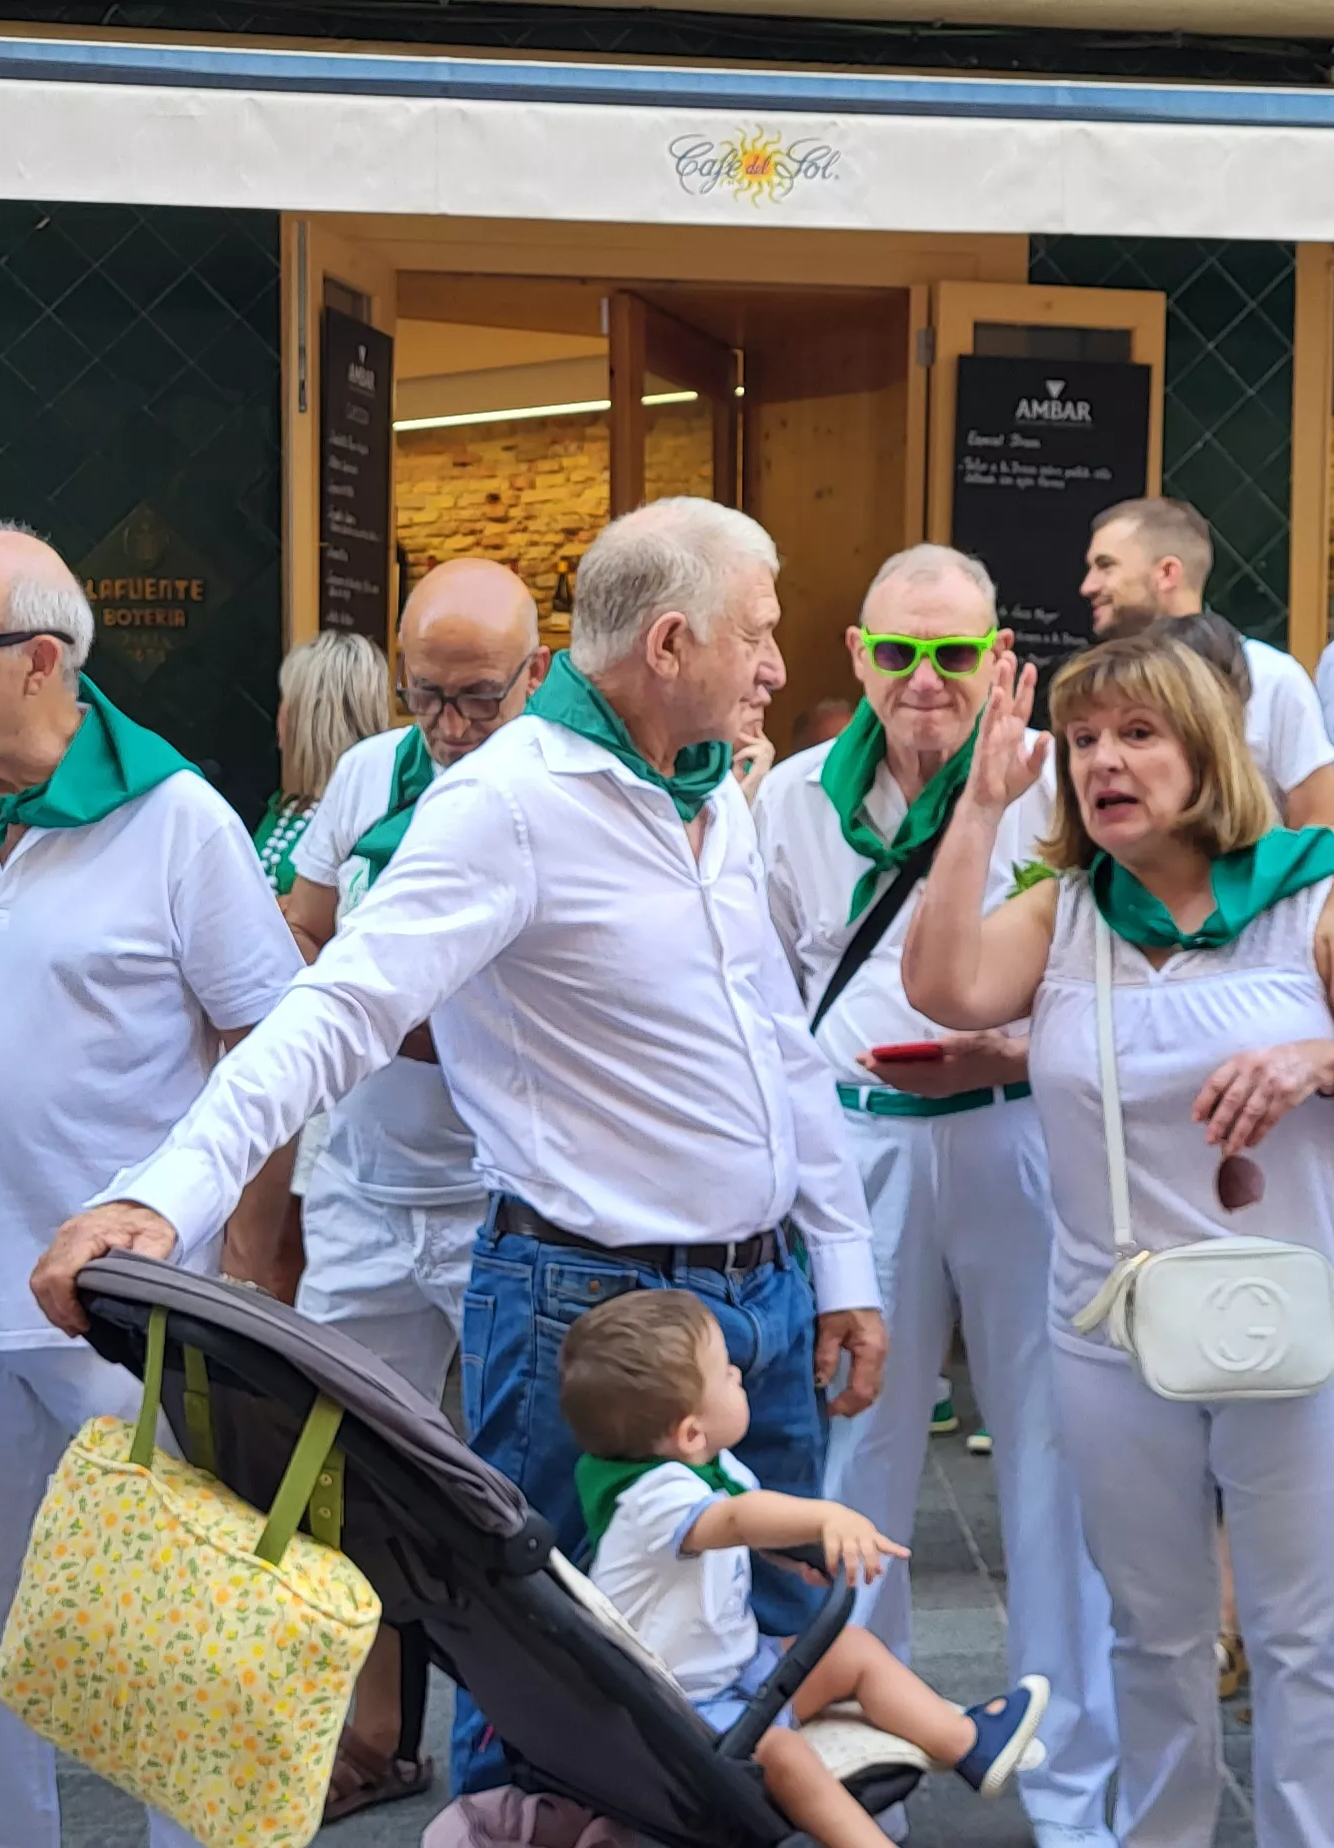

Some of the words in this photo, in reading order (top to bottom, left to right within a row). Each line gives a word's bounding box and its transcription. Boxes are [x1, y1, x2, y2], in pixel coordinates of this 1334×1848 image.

[1016, 399, 1092, 423] AMBAR
[85, 578, 205, 602] LAFUENTE
[103, 607, 186, 628] BOTERIA
